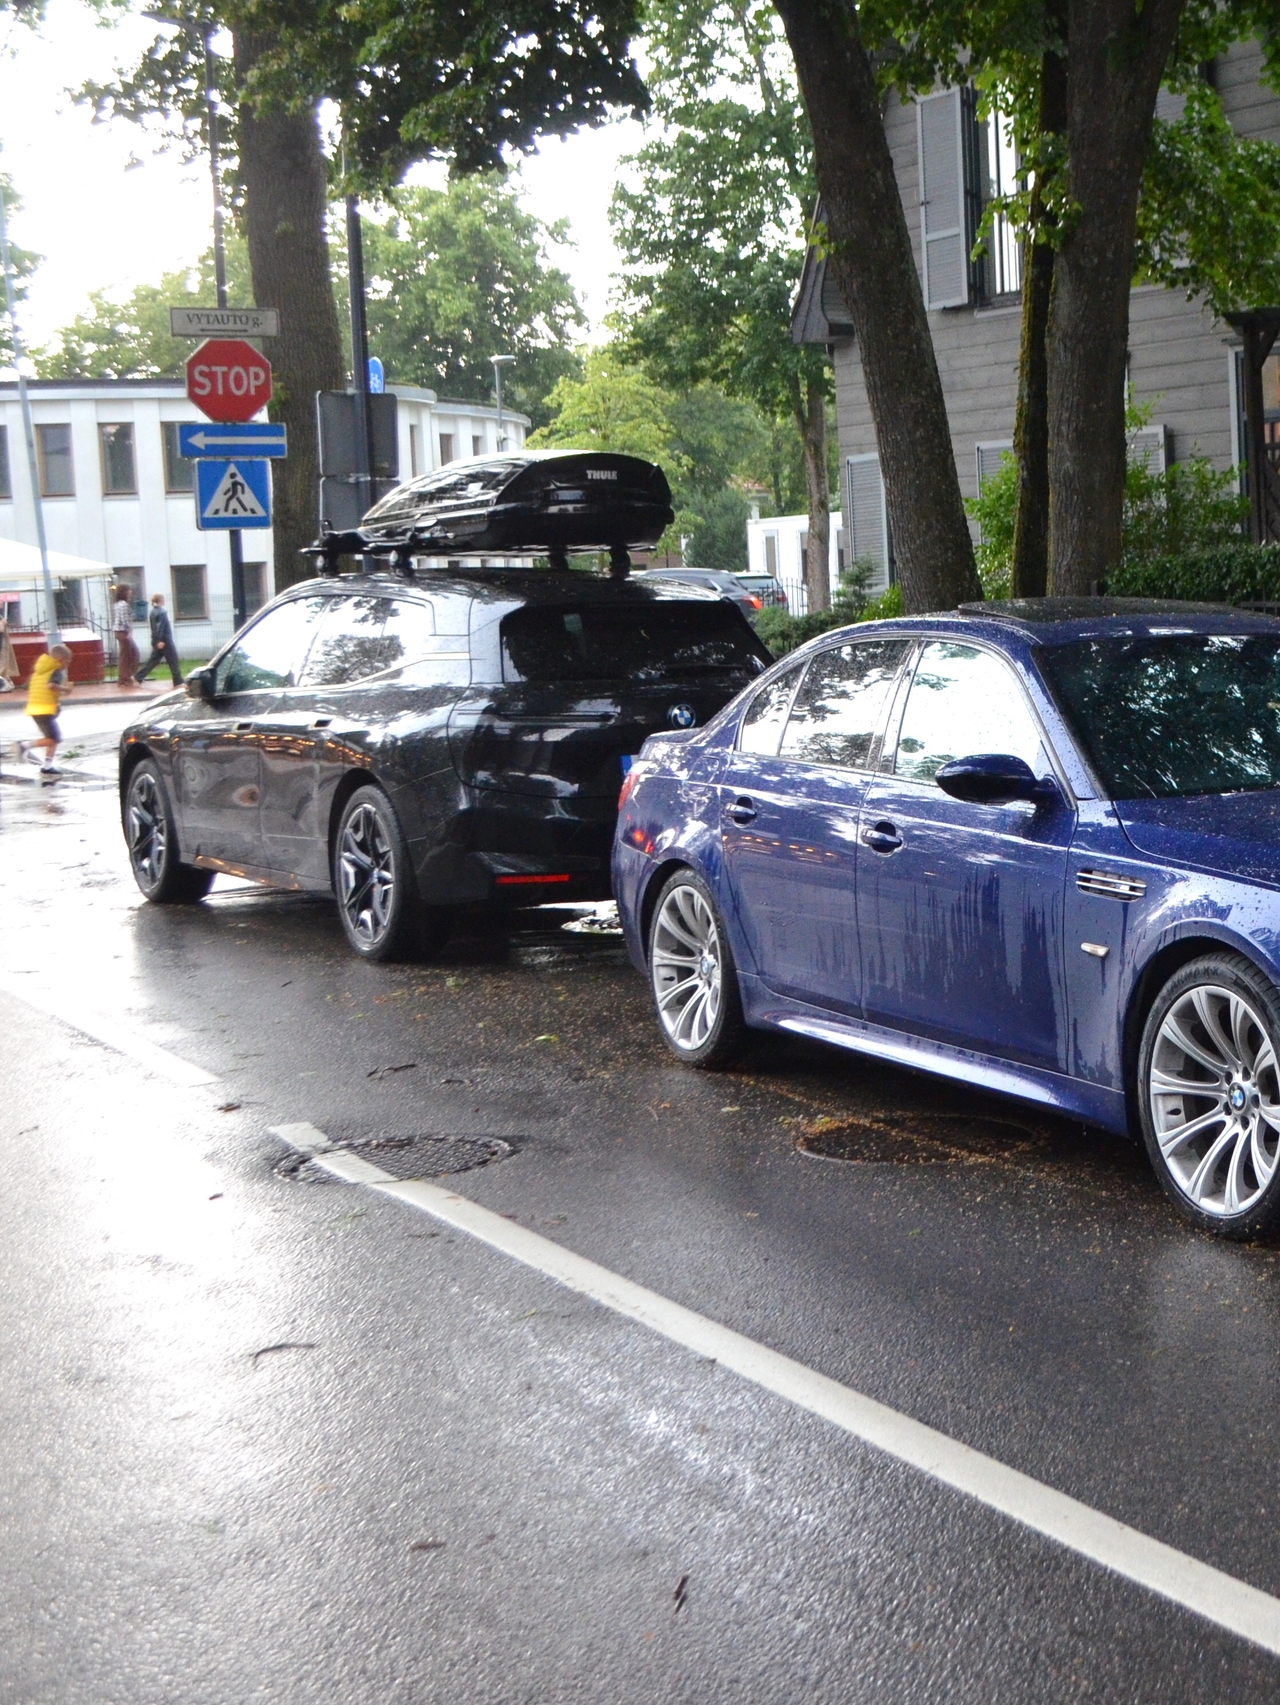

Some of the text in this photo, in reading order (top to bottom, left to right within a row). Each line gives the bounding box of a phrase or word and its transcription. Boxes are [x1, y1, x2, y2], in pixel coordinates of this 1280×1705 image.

[186, 313, 249, 325] VYTAUTO
[194, 365, 265, 396] STOP
[586, 469, 618, 480] THULE
